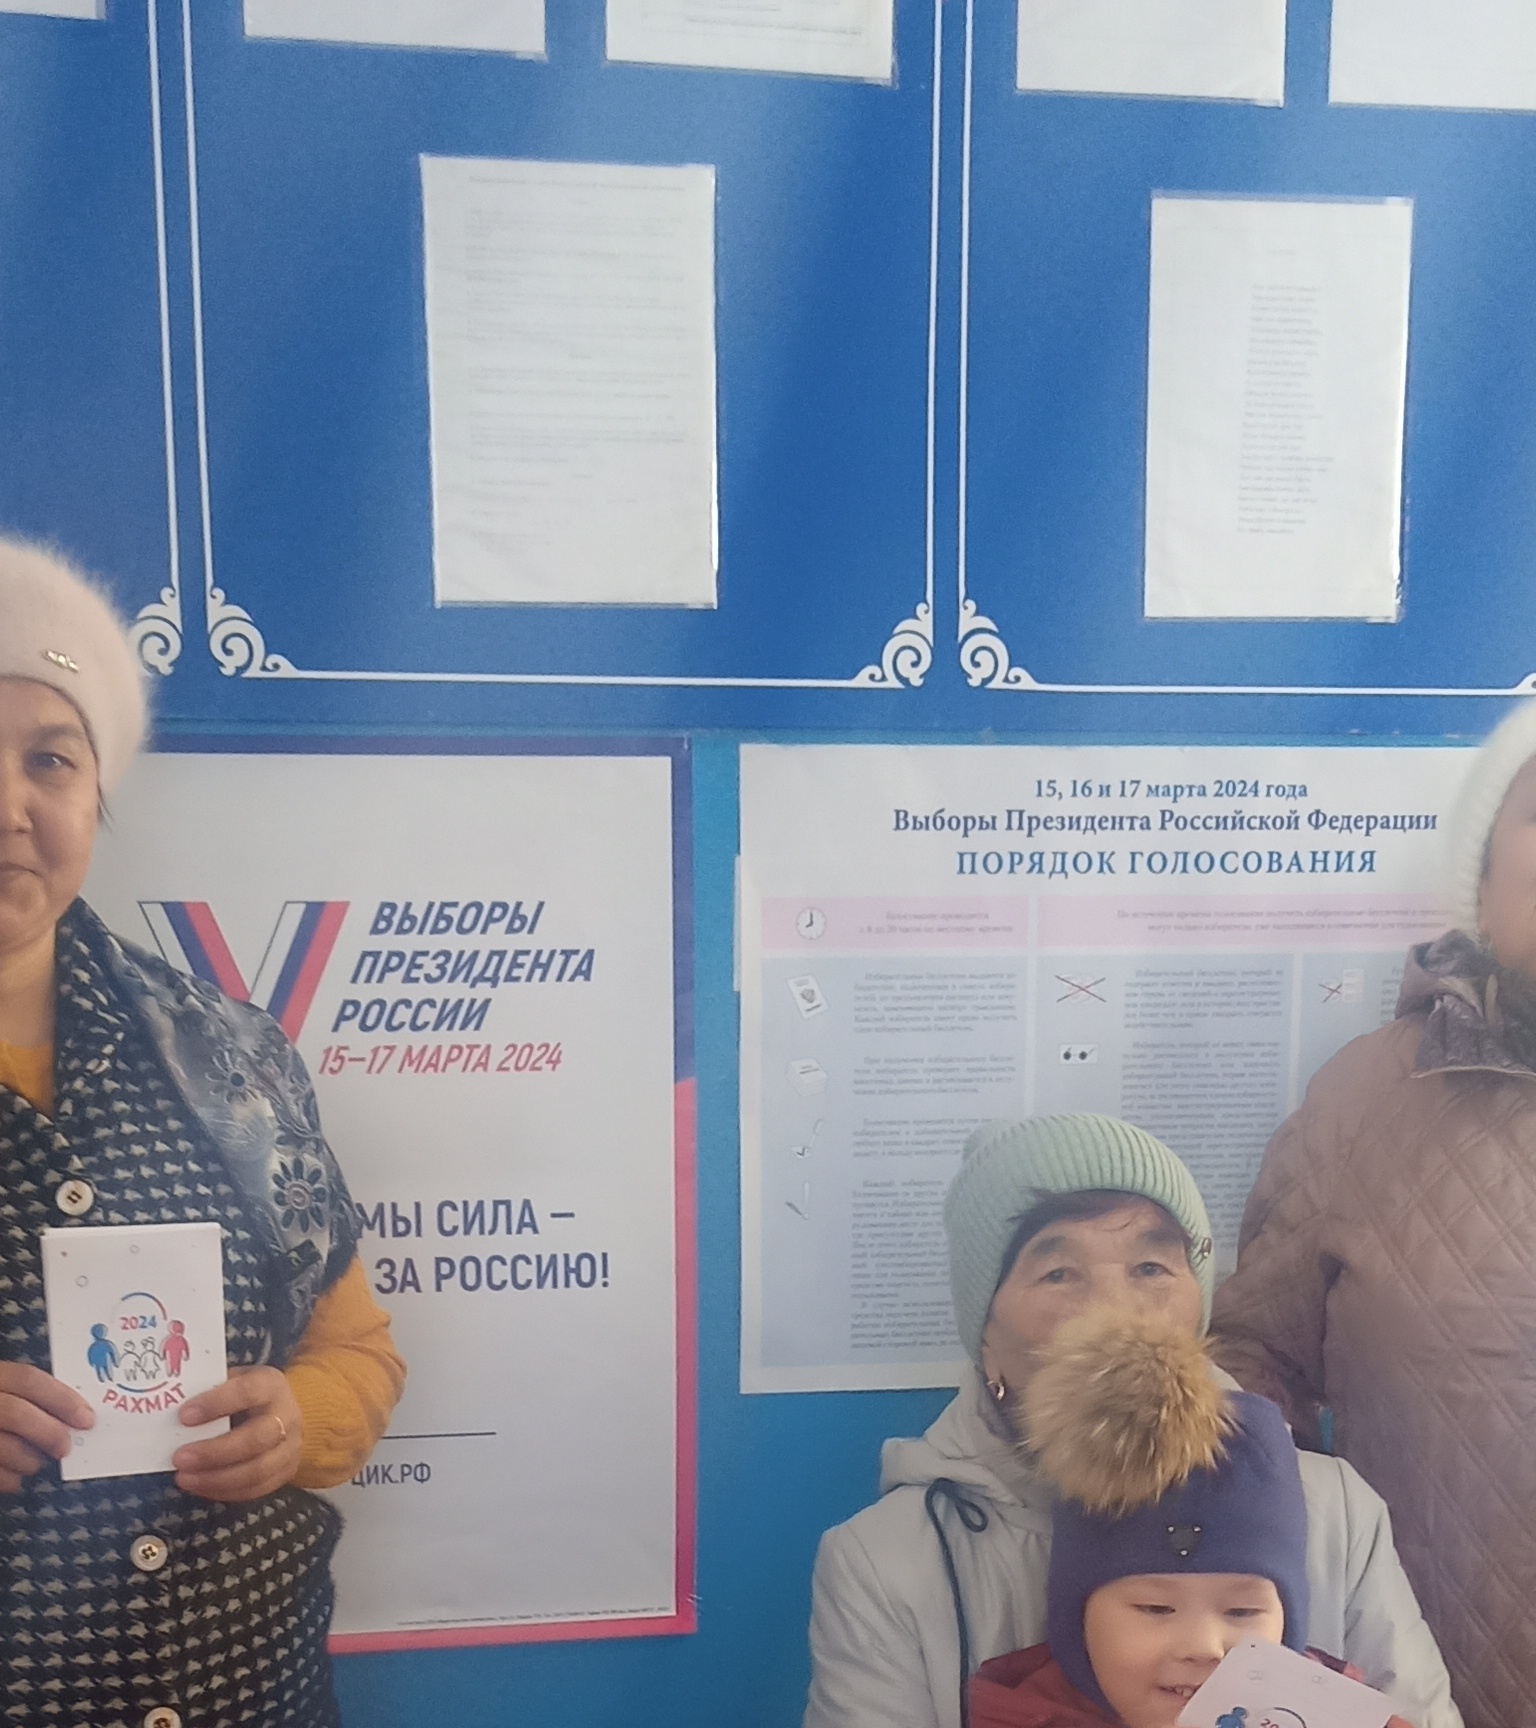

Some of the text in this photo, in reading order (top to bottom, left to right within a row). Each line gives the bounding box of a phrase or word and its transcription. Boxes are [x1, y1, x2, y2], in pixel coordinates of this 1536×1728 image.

[1035, 780, 1308, 802] 15, 16 и 17 марта 2024 года
[893, 808, 1438, 838] Выборы Президента Российской Федерации
[956, 850, 1378, 879] ПОРЯДОК ГОЛОСОВАНИЯ
[369, 900, 545, 936] ВЫБОРЫ
[350, 948, 595, 987] ПРЕЗИДЕНТА
[332, 998, 492, 1034] РОССИИ
[398, 1043, 491, 1074] МАРТА
[496, 1042, 563, 1073] 2024
[360, 1202, 423, 1238] МЫ
[436, 1198, 539, 1238] СИЛА
[374, 1252, 611, 1293] ЗА РОССИЮ!
[120, 1315, 157, 1331] 2024
[102, 1383, 186, 1415] РАХМАТ
